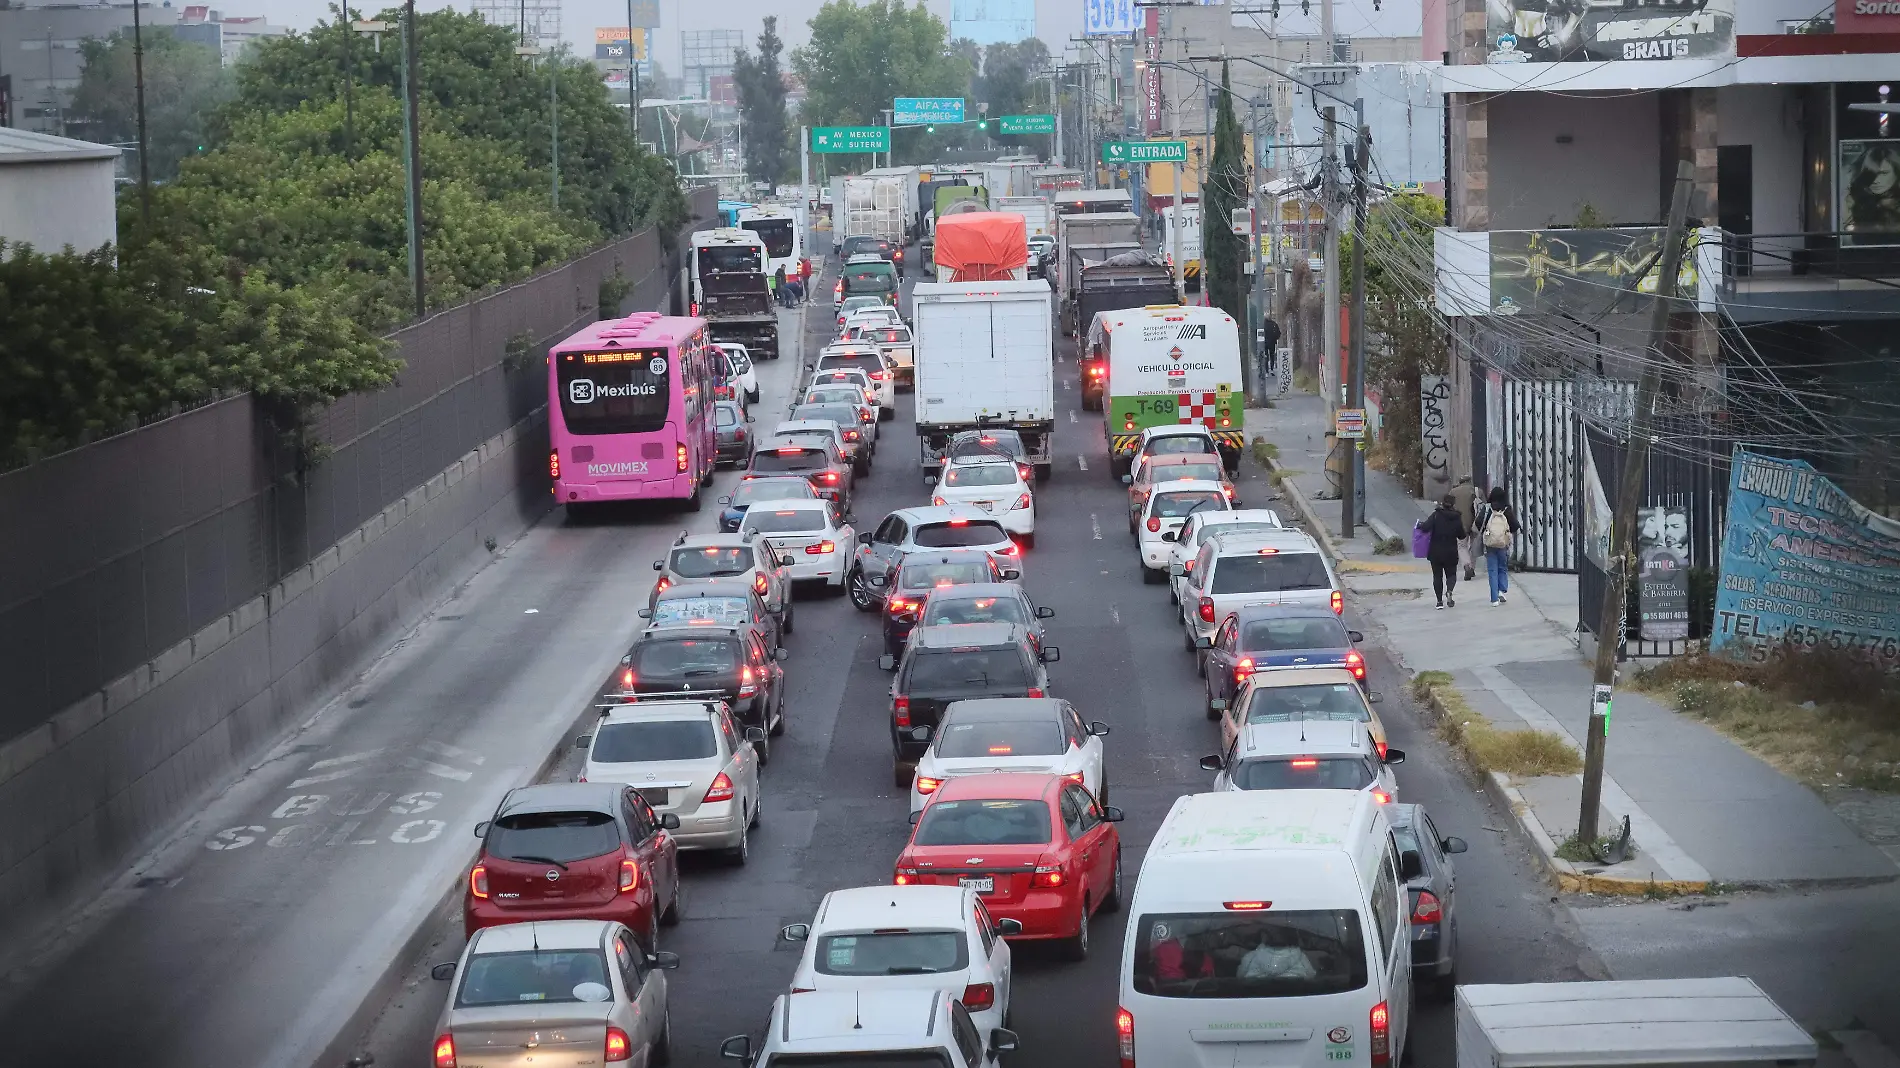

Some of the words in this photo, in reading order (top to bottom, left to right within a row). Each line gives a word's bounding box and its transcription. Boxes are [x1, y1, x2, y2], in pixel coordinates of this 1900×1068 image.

[1623, 39, 1689, 60] GRATIS
[915, 101, 939, 110] AIFA
[1131, 145, 1182, 158] ENTRADA
[1182, 362, 1215, 371] OFICIAL
[596, 382, 656, 398] Mexibús
[1137, 399, 1174, 415] T-69
[588, 461, 648, 474] MOVIMEX
[1738, 452, 1793, 502] LAVADO
[1793, 466, 1816, 507] DE
[1807, 607, 1864, 627] EXPRESS
[1867, 616, 1886, 630] EN
[270, 791, 444, 819] BUS
[205, 819, 446, 851] SOLO
[1327, 1051, 1352, 1060] 188
